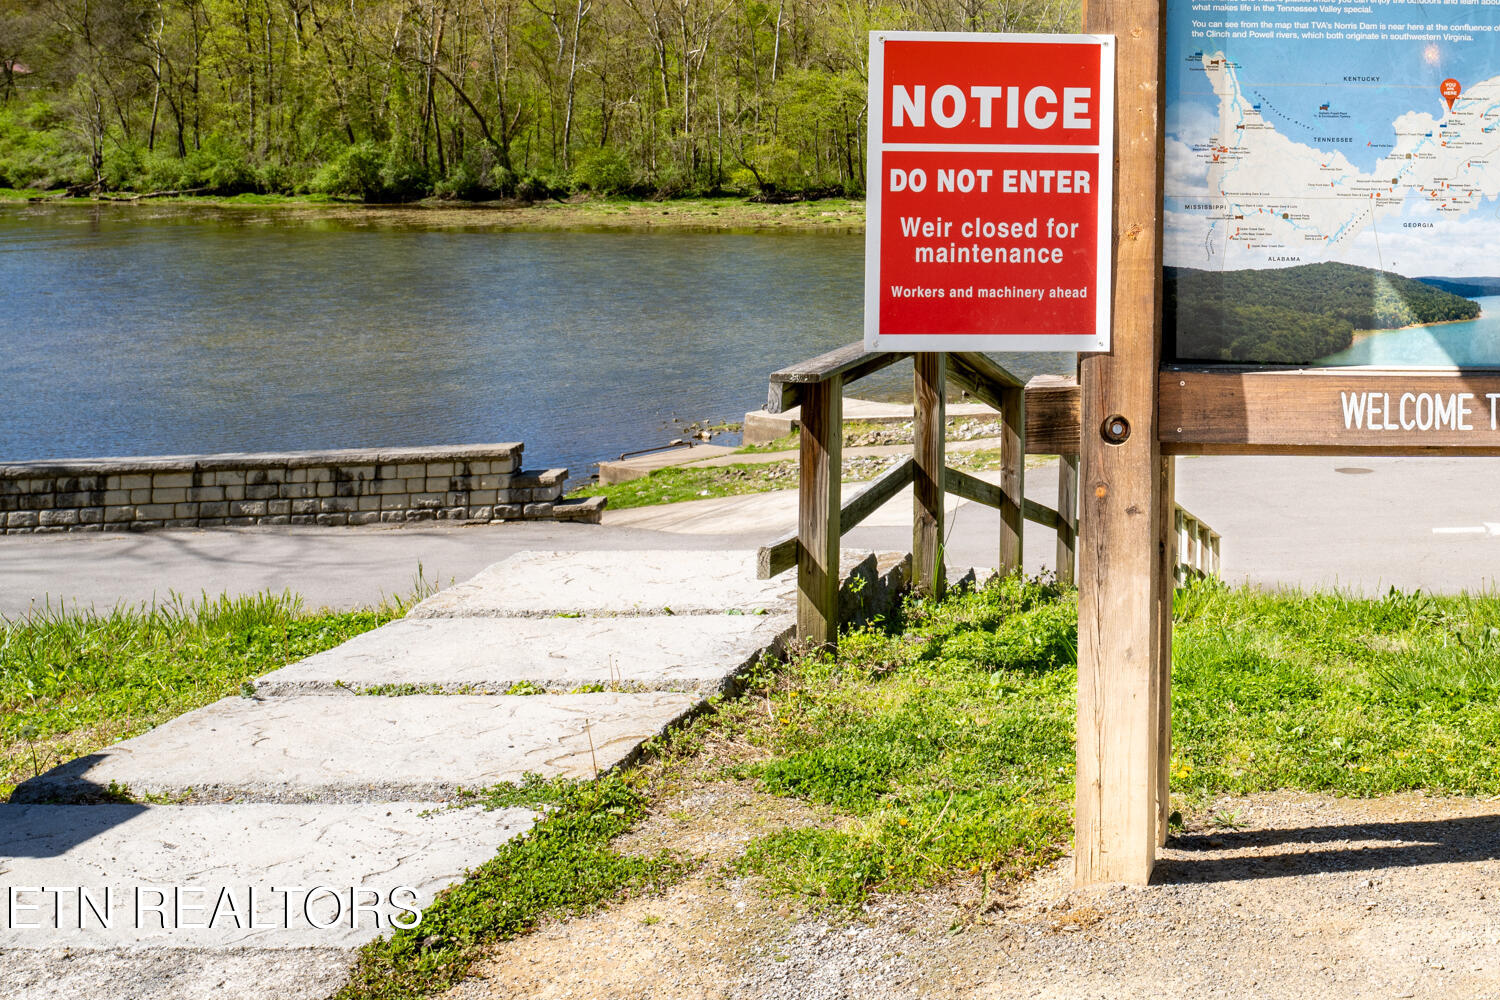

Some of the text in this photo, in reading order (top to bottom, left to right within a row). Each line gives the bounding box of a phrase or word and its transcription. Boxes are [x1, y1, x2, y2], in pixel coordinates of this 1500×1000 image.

[1319, 6, 1341, 14] Valley
[1343, 6, 1373, 15] special.
[1346, 33, 1379, 41] originate
[1443, 34, 1473, 43] Virginia.
[1436, 23, 1448, 31] the
[892, 84, 1092, 130] NOTICE
[890, 168, 1091, 194] DO NOT ENTER
[900, 216, 1079, 239] Weir closed for
[915, 242, 1064, 264] maintenance
[891, 285, 1088, 301] Workers and machinery ahead
[1340, 391, 1475, 431] WELCOME
